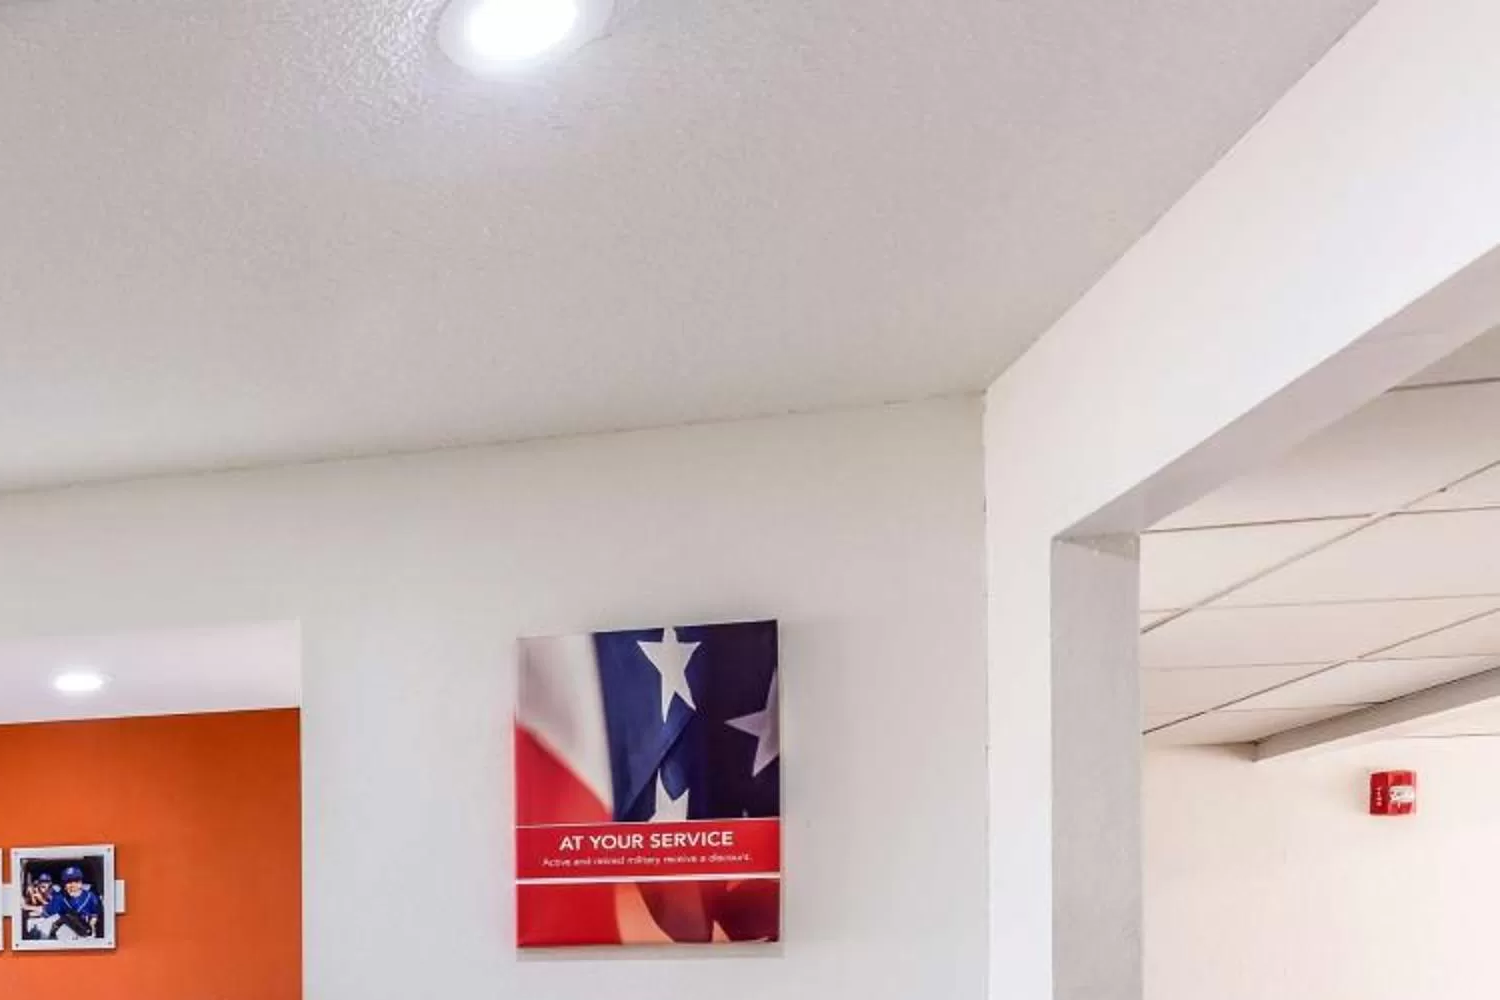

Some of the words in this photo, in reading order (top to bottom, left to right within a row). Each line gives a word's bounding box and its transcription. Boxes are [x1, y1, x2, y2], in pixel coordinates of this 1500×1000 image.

[559, 835, 584, 851] AT
[590, 834, 644, 849] YOUR
[650, 831, 734, 849] SERVICE
[543, 858, 571, 867] Active
[574, 856, 590, 865] and
